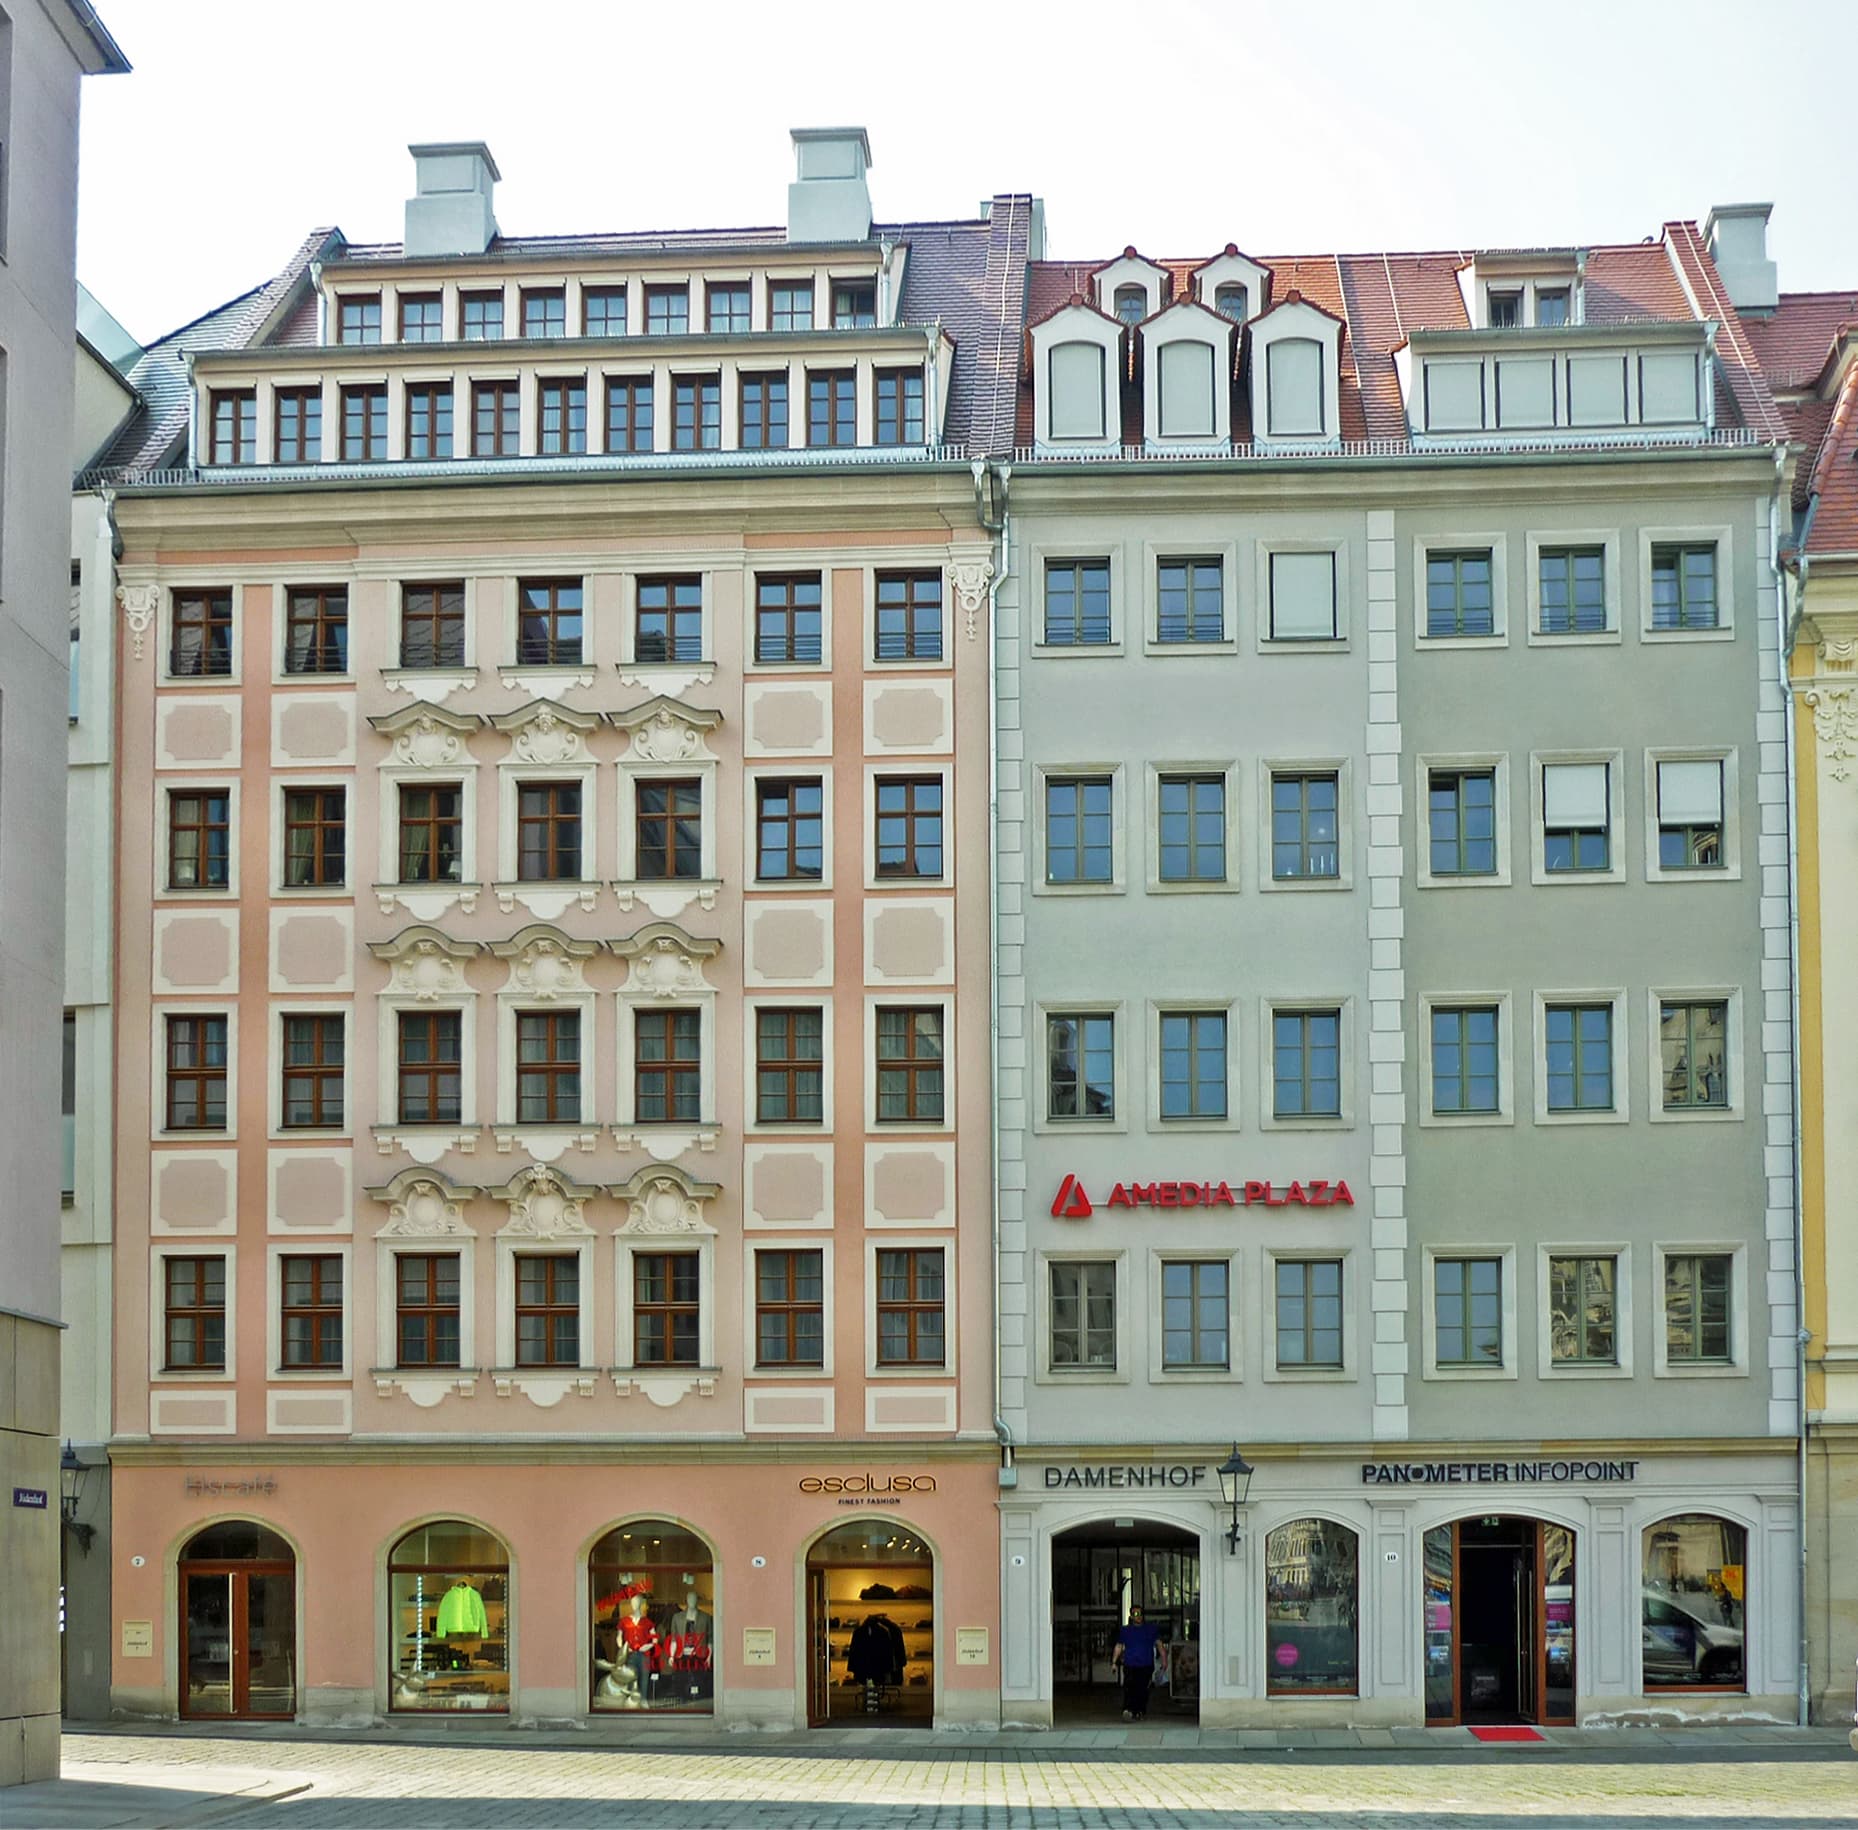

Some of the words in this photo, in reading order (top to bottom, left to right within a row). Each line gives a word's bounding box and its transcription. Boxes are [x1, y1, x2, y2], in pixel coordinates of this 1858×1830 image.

[1107, 1181, 1235, 1208] AMEDIA
[1244, 1179, 1354, 1206] PLAZA
[799, 1472, 937, 1493] esclusa
[1045, 1466, 1206, 1487] DAMENHOF
[1361, 1463, 1508, 1483] PANOMETER
[1514, 1461, 1639, 1481] INFOPOINT
[867, 1497, 901, 1505] FASHION
